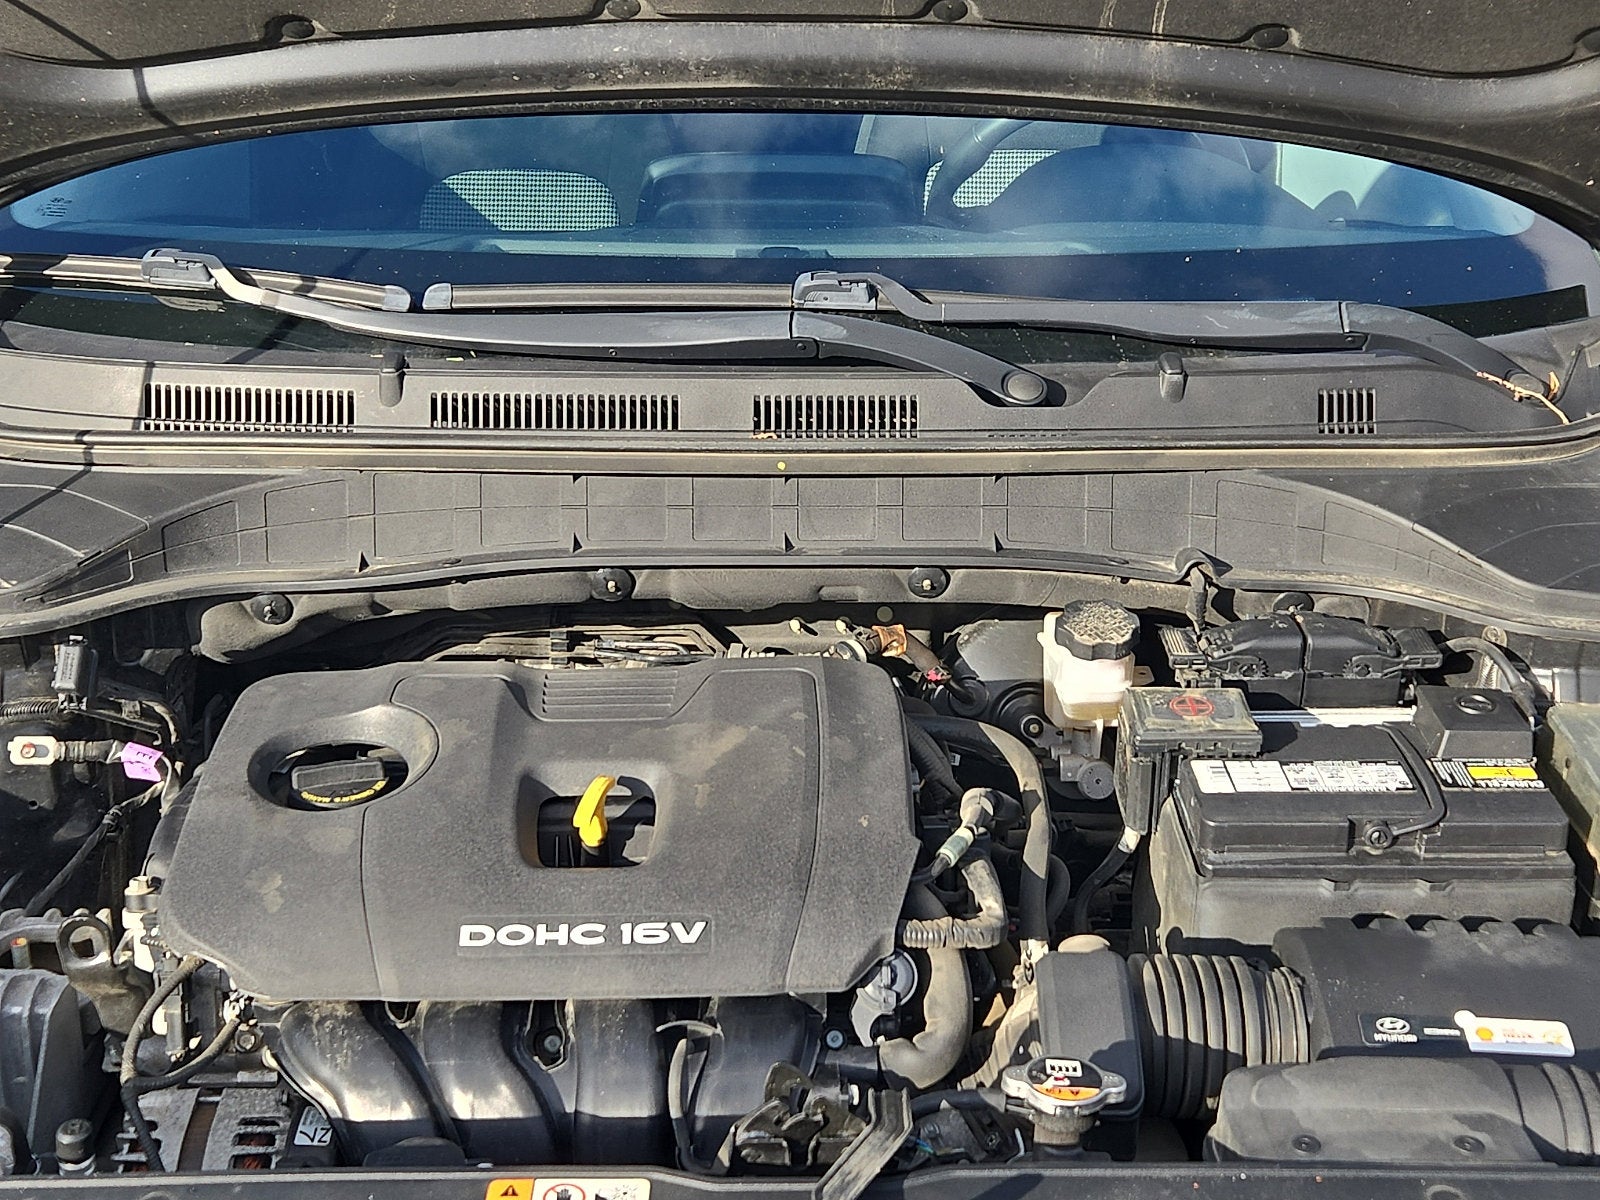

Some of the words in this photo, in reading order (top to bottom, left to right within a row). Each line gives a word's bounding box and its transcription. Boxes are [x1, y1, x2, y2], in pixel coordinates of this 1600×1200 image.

[458, 923, 608, 947] DOHC
[620, 921, 708, 945] 16V
[1373, 1032, 1418, 1043] HYUNDAI
